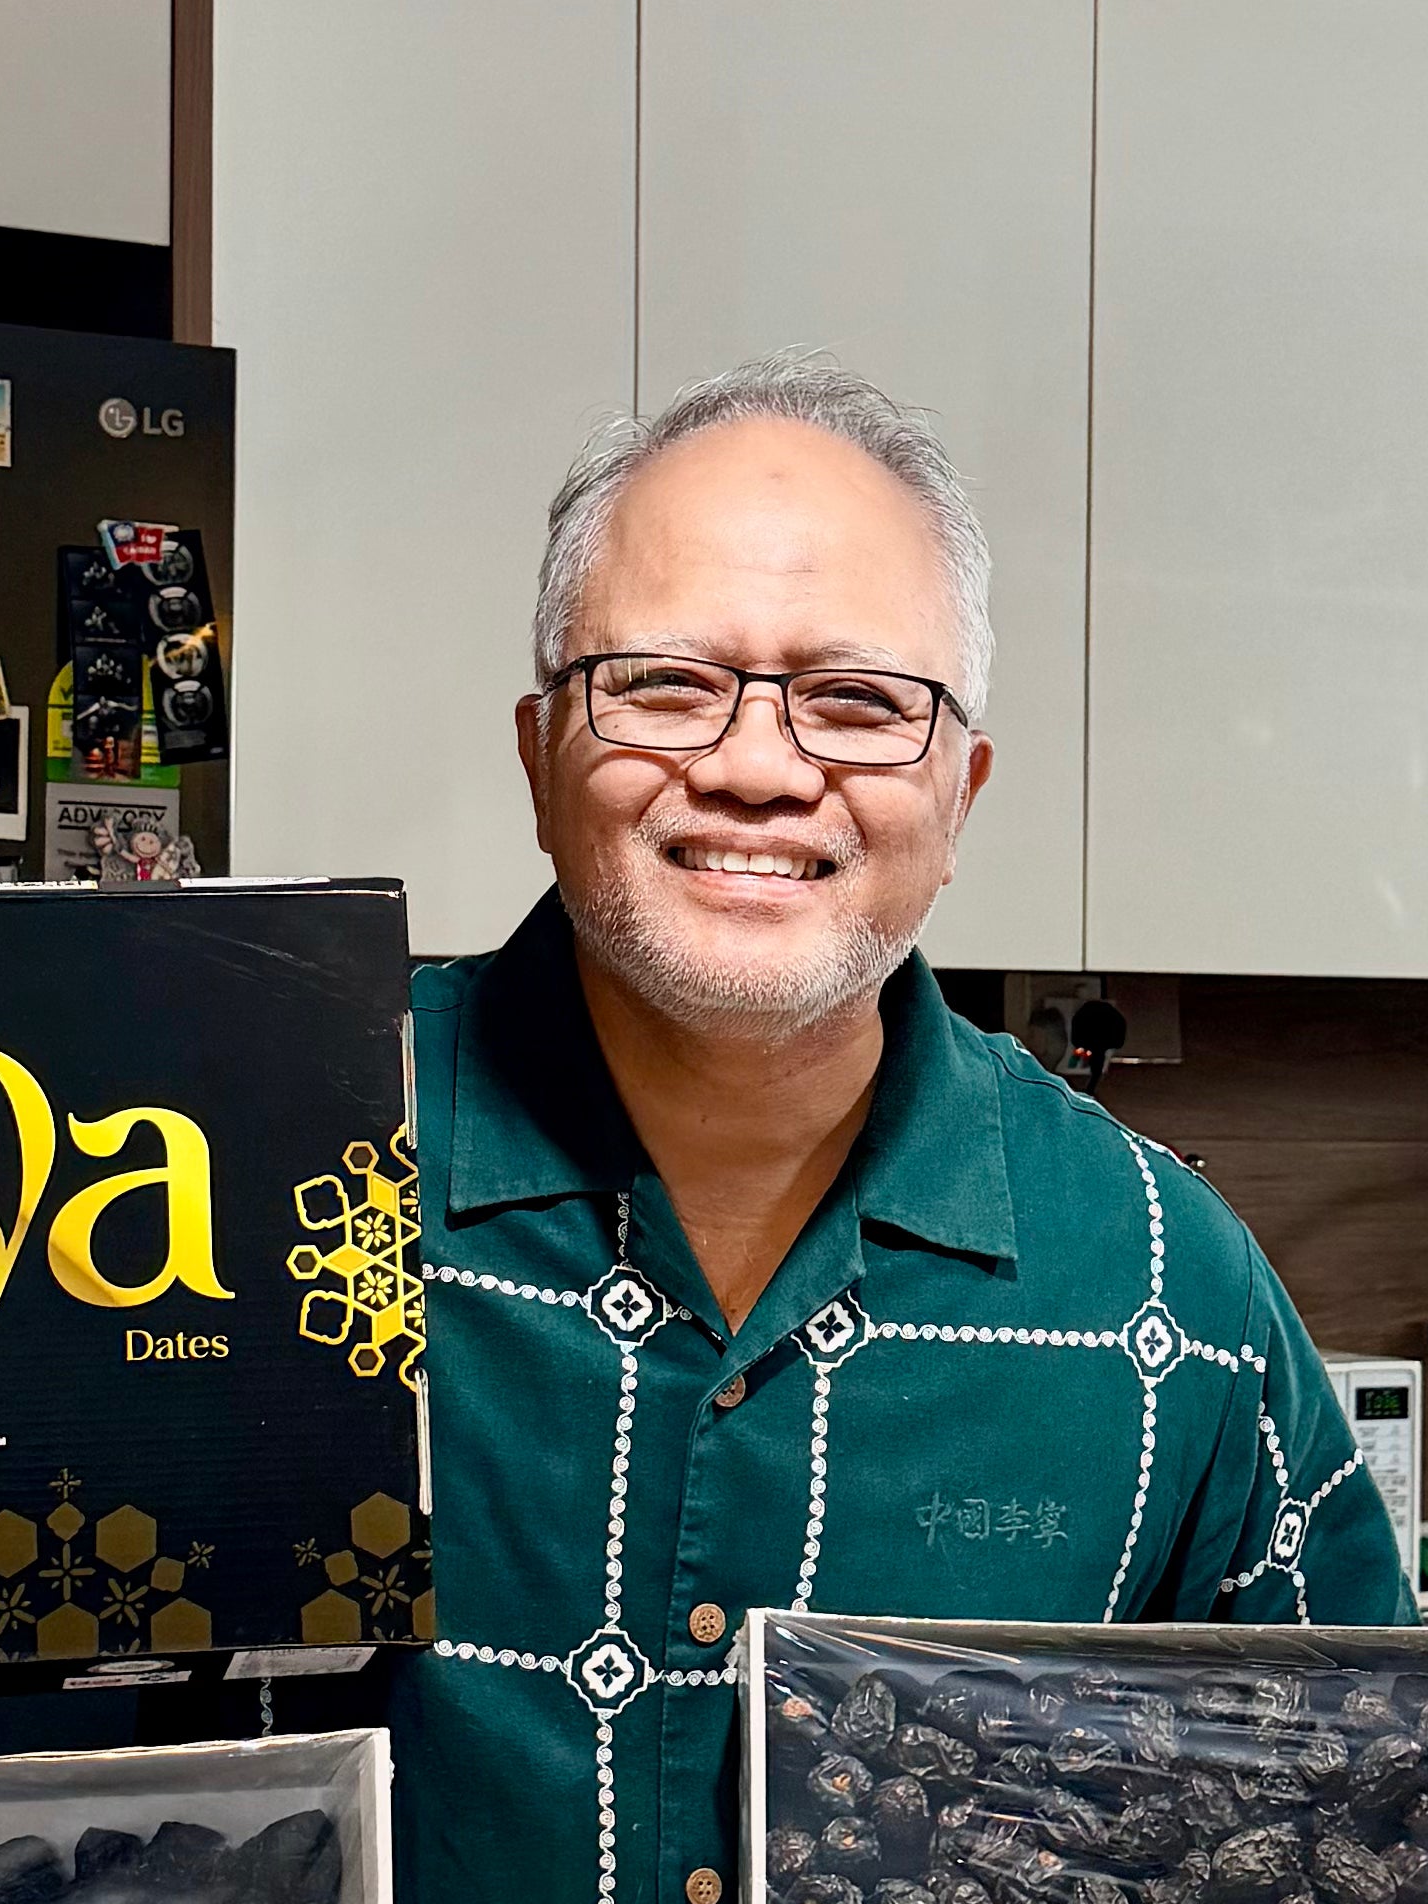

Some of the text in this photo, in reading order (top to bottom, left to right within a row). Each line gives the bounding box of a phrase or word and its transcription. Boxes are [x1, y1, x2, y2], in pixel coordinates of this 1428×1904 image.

[142, 406, 185, 437] LG
[58, 807, 166, 825] ADVORY
[125, 1328, 231, 1362] Dates
